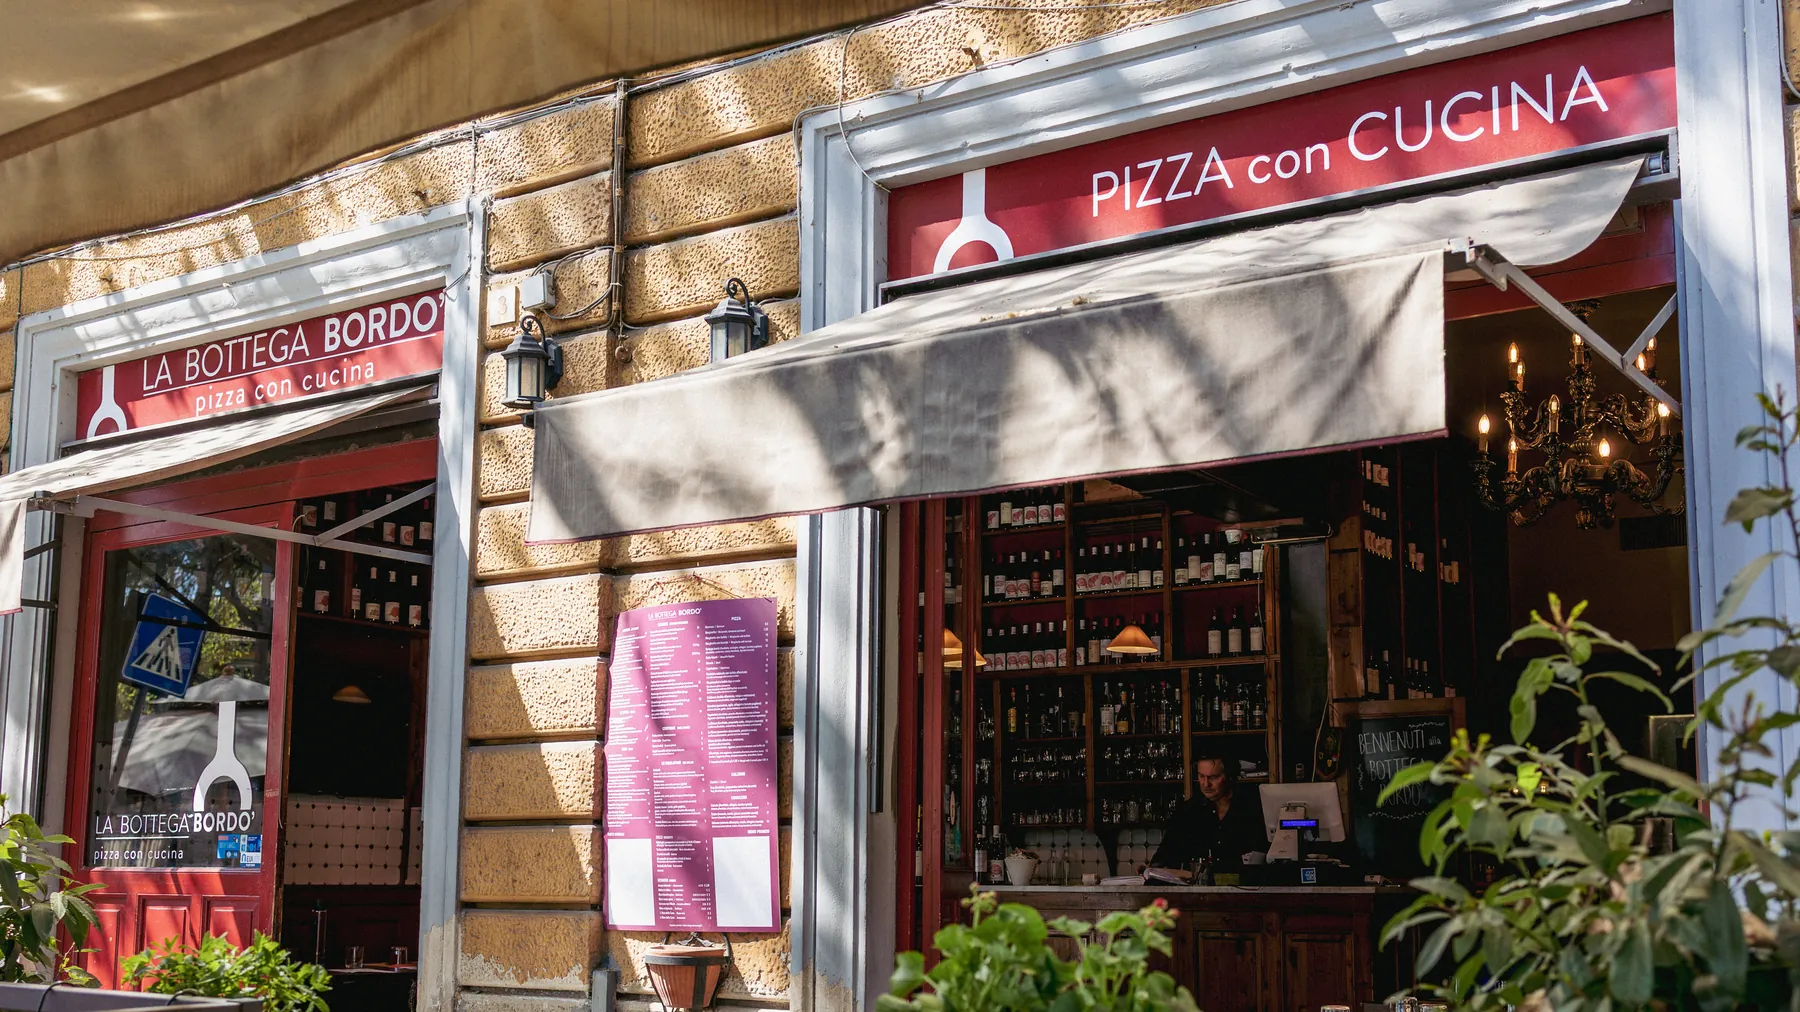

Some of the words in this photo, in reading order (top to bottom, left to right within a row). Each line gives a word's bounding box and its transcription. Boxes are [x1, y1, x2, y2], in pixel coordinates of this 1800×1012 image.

[1092, 146, 1235, 217] PIZZA
[1247, 142, 1331, 184] con
[1347, 65, 1609, 162] CUCINA
[498, 295, 508, 315] 3
[142, 356, 173, 391] LA
[185, 325, 310, 382] BOTTEGA
[324, 292, 446, 353] BORDO'
[195, 385, 246, 417] pizza
[254, 377, 293, 400] con
[302, 358, 375, 392] cucina
[1358, 730, 1424, 755] BENVENUTI
[1429, 736, 1442, 746] alla
[96, 815, 113, 834] LA
[120, 813, 190, 834] BOTTEGA
[193, 811, 255, 832] BORDO'
[94, 846, 120, 864] pizza
[123, 849, 143, 860] con
[148, 846, 184, 860] cucina
